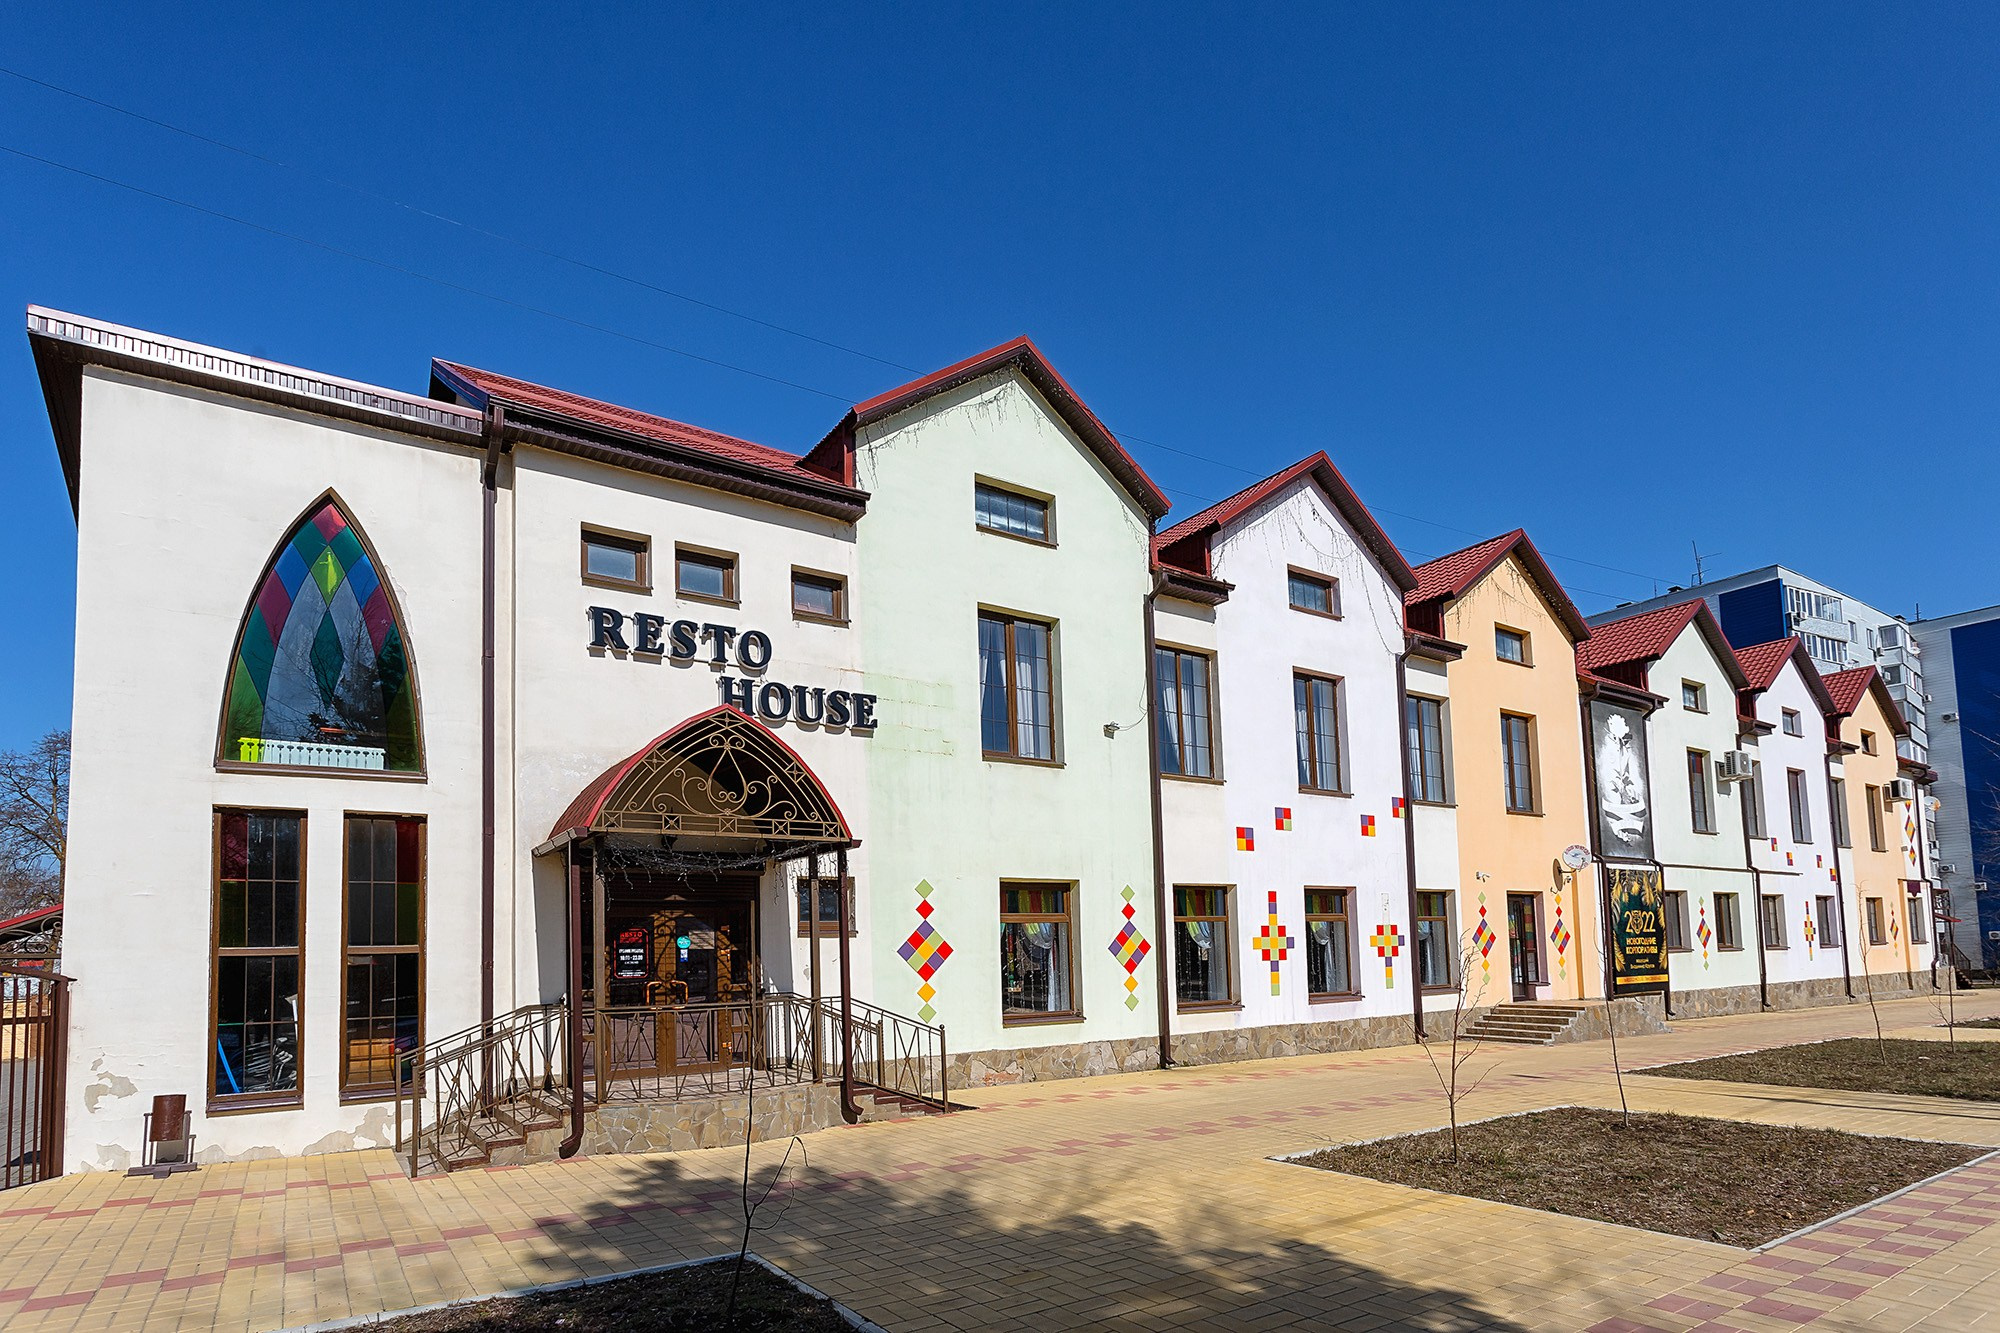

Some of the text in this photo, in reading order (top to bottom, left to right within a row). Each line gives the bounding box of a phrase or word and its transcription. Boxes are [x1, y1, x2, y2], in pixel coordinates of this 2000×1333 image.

[587, 605, 773, 669] RESTO
[719, 676, 878, 729] HOUSE
[1626, 937, 1657, 946] НОВОГОДНИЕ
[1626, 946, 1658, 955] КОРПОРАТИВЫ
